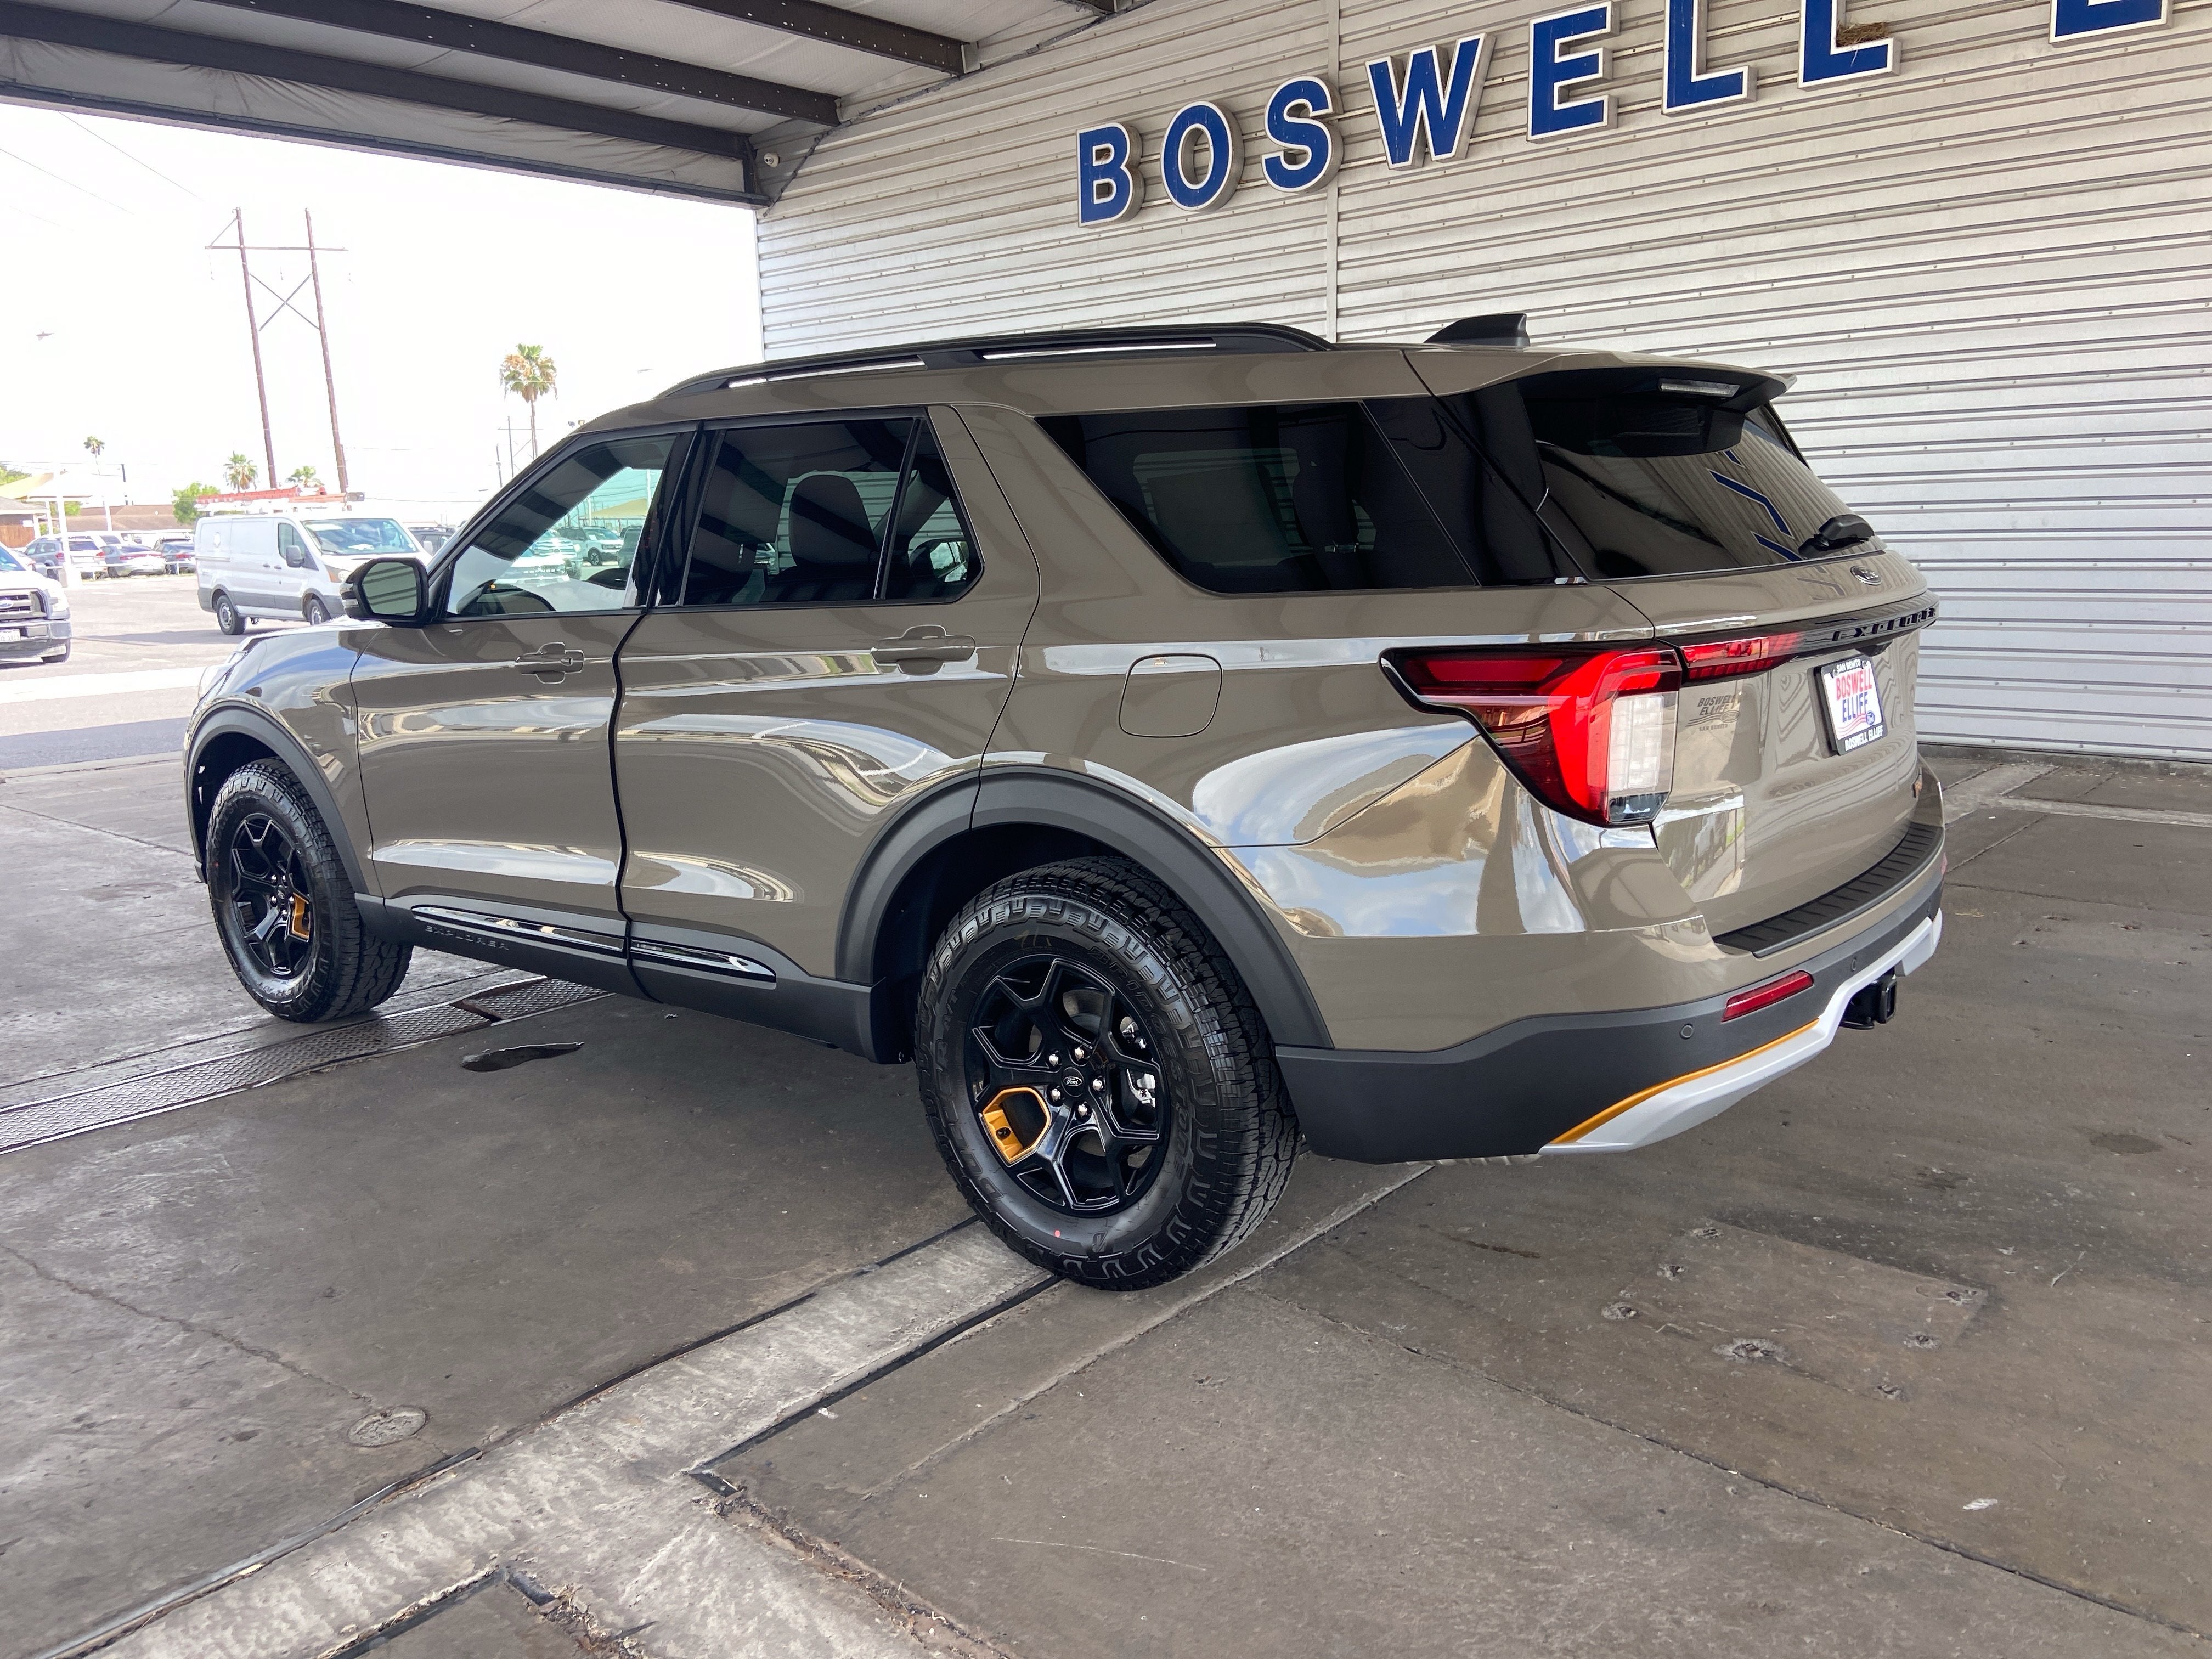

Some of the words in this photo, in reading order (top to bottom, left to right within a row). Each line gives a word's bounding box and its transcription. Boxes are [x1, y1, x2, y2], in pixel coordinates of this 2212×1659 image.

[1076, 0, 1901, 228] BOSWELL
[1836, 663, 1846, 673] SAN
[1846, 658, 1861, 669] BENITO
[1836, 668, 1872, 701] BOSWELL
[1697, 695, 1736, 707] BOSWELL
[1842, 692, 1868, 723] ELLIFF
[1844, 731, 1869, 752] BOSWELL
[1868, 725, 1883, 740] ELLIFF
[425, 926, 509, 951] EXPLORER
[1086, 945, 1192, 1181] BRIDGESTONE
[933, 1037, 1005, 1204] DUELER
